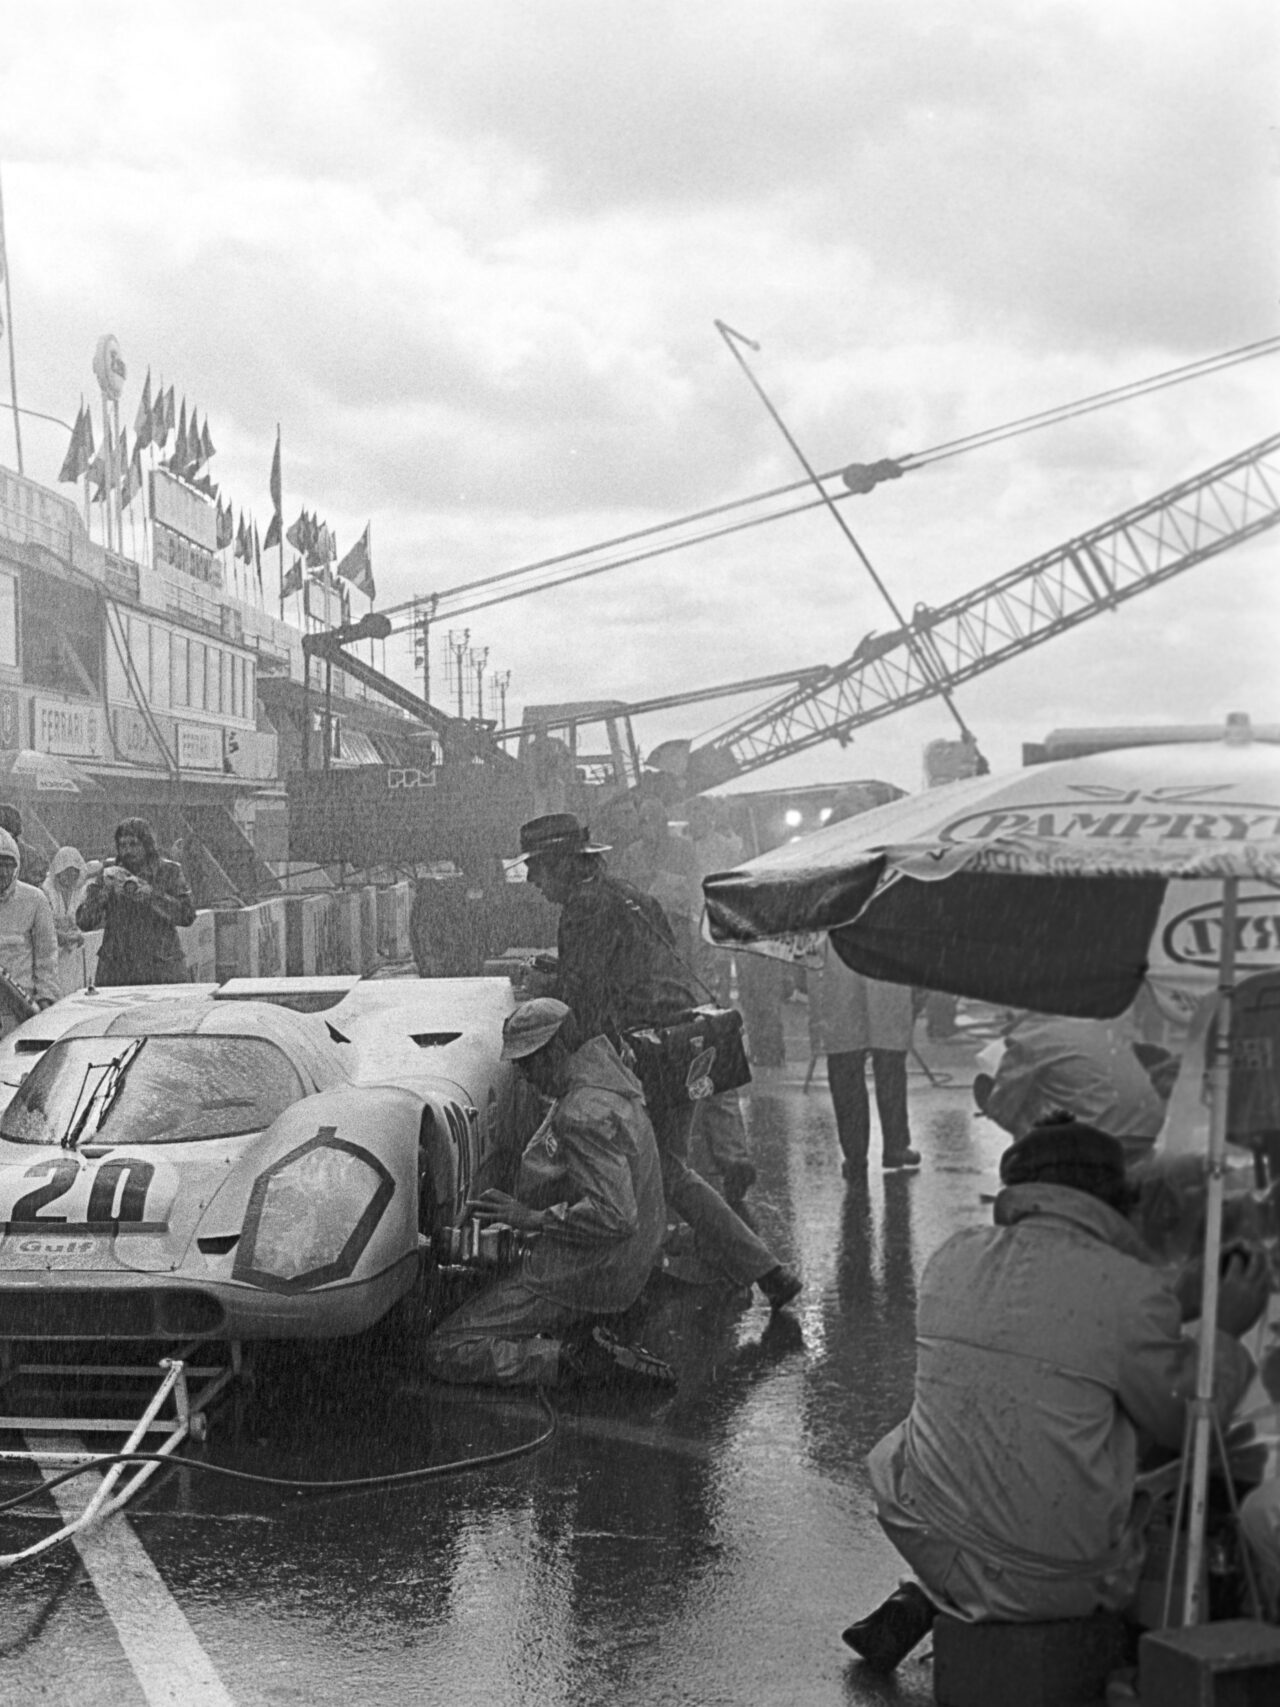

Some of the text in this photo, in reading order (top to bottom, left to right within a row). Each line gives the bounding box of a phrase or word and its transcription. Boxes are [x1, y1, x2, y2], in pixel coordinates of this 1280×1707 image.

[967, 813, 1280, 840] PAMPRY
[11, 1158, 155, 1222] 20
[21, 1240, 94, 1252] Gulf
